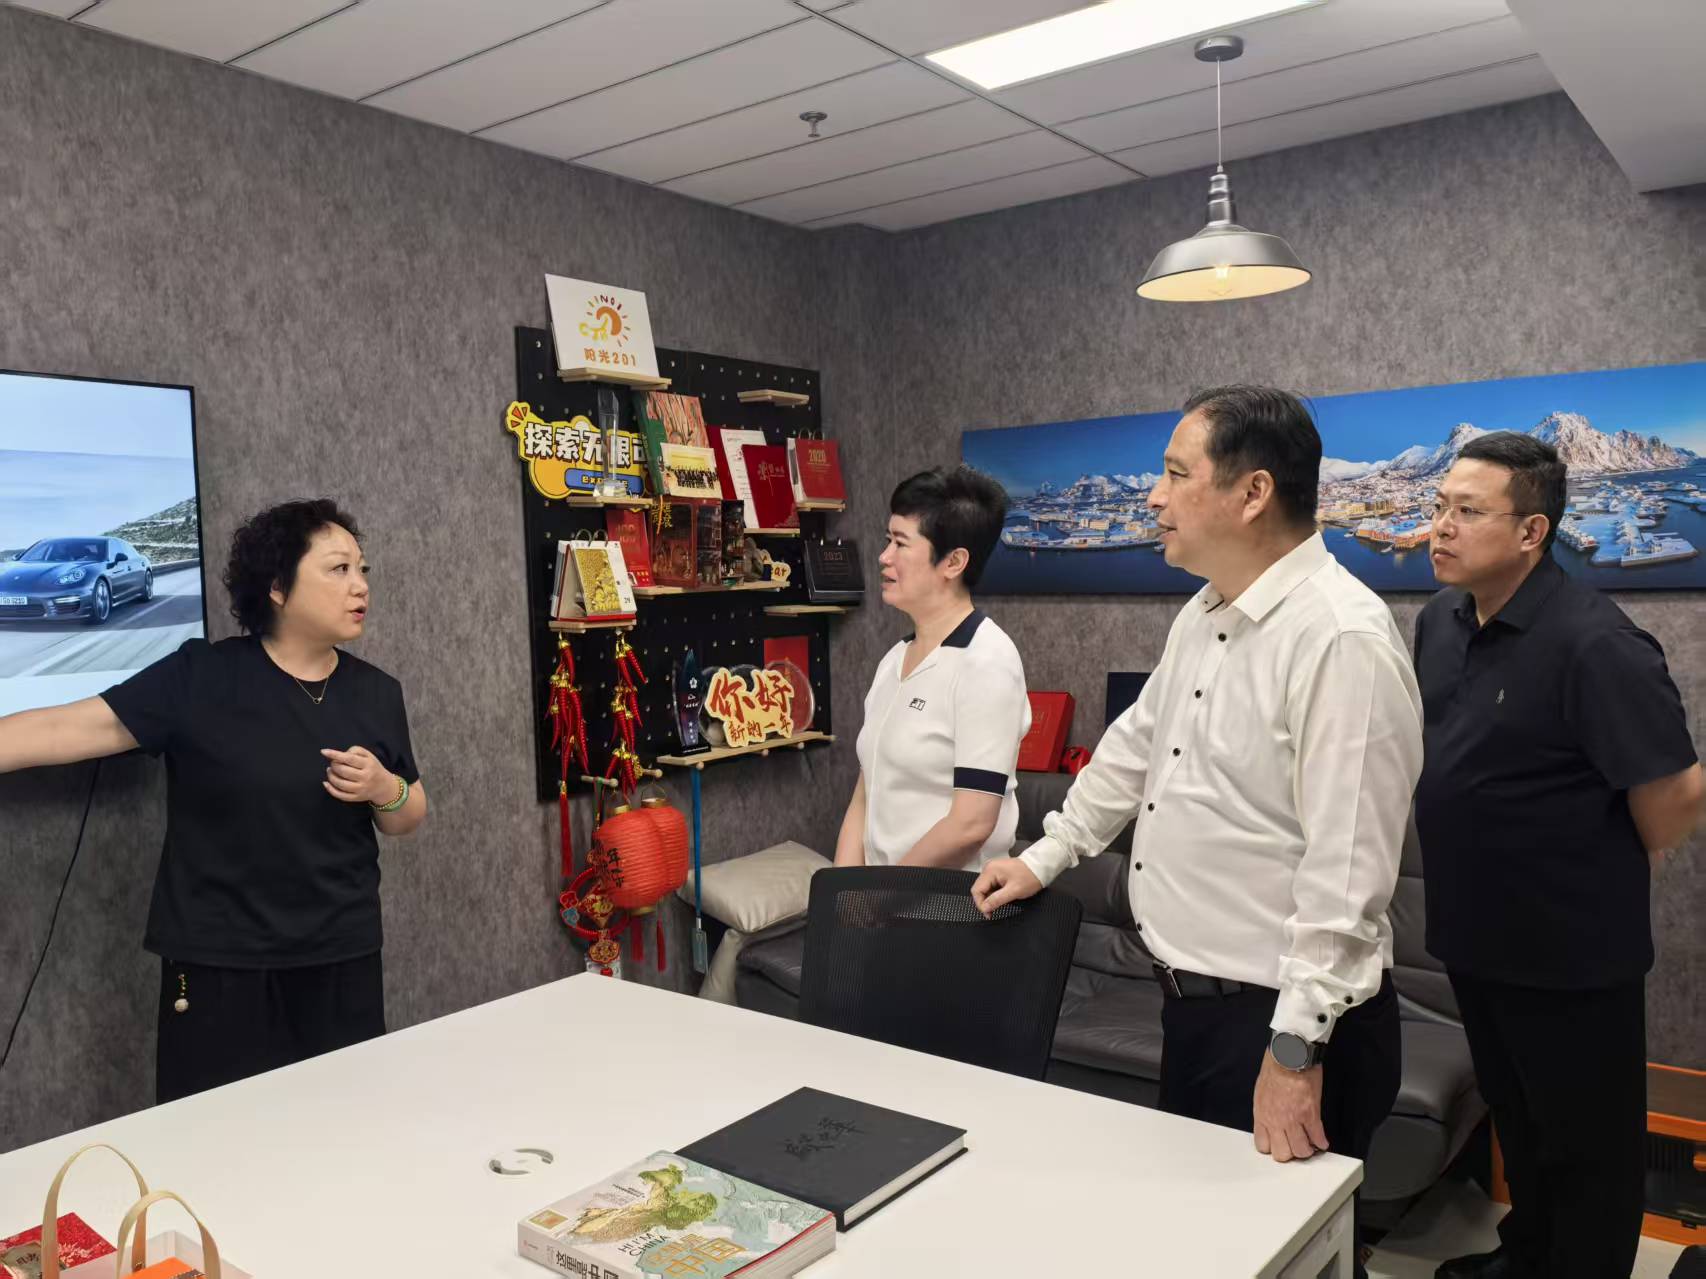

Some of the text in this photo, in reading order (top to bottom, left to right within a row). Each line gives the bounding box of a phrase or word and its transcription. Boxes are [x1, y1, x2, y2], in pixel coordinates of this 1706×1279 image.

[584, 347, 637, 367] 阳光201
[709, 672, 792, 724] 你好
[729, 713, 791, 741] 新的一年
[629, 1234, 672, 1257] CHINA
